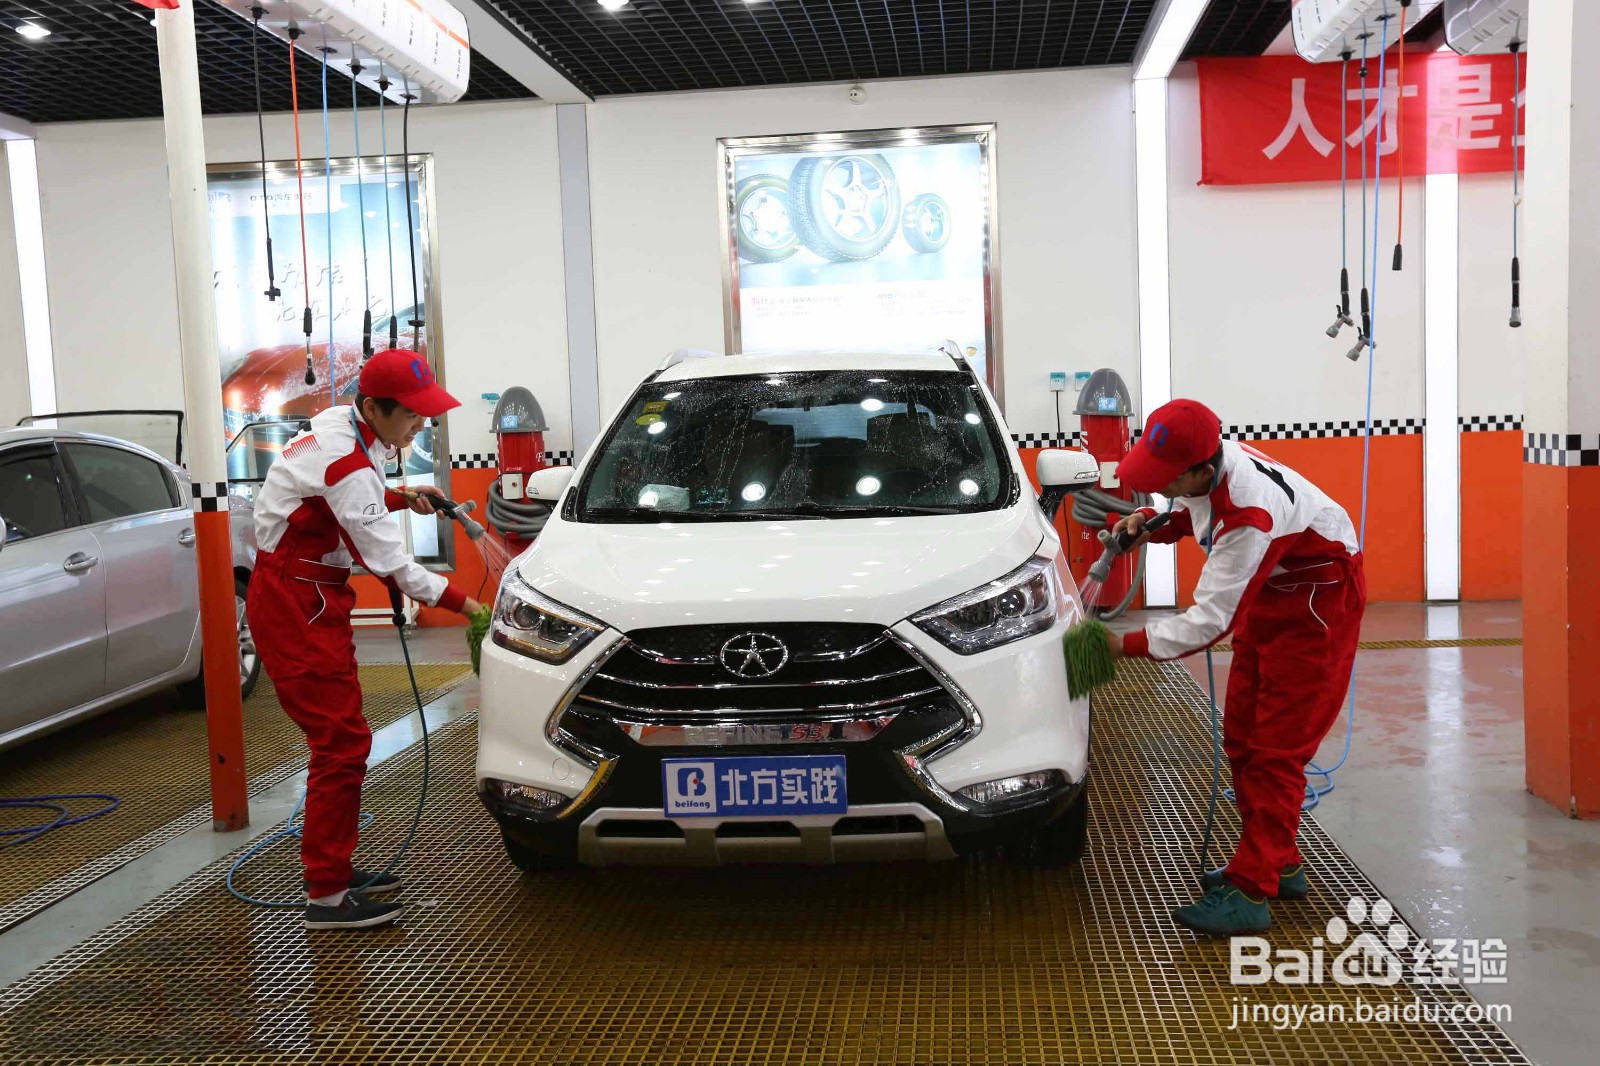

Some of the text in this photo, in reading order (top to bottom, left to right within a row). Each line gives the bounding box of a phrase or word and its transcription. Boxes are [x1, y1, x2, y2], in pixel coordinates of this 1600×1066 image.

[790, 725, 824, 740] S3
[721, 767, 838, 806] 北方实践
[675, 800, 711, 810] beifang
